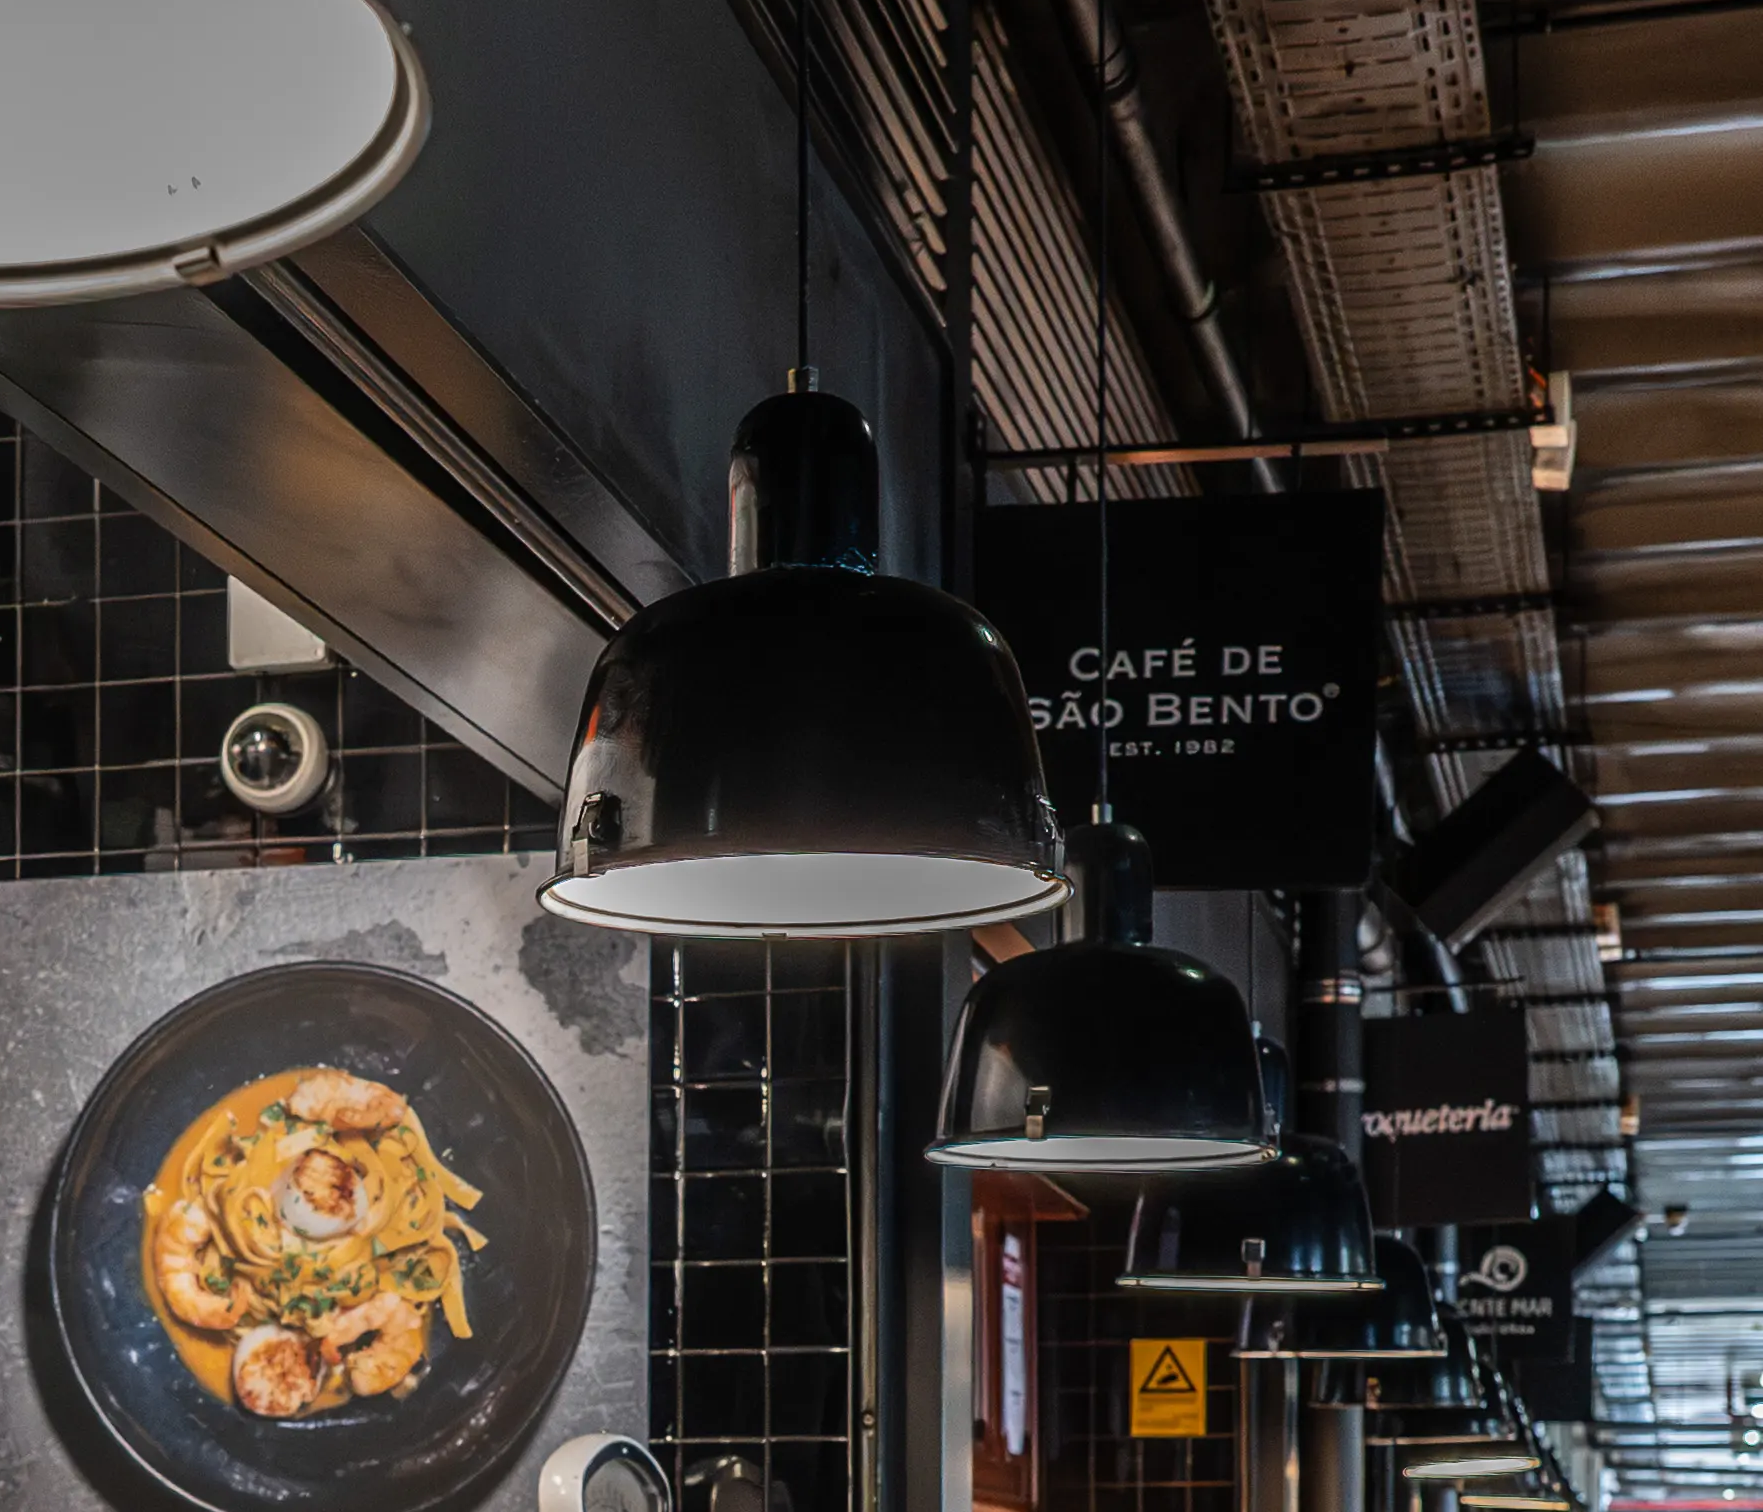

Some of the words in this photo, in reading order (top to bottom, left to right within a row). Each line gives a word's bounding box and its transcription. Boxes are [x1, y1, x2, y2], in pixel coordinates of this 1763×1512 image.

[1070, 638, 1196, 681] CAFÉ
[1222, 645, 1283, 676] DE
[1027, 691, 1124, 730] SÃO
[1147, 692, 1323, 727] BENTO
[1109, 742, 1162, 757] EST.
[1174, 739, 1236, 756] 1982
